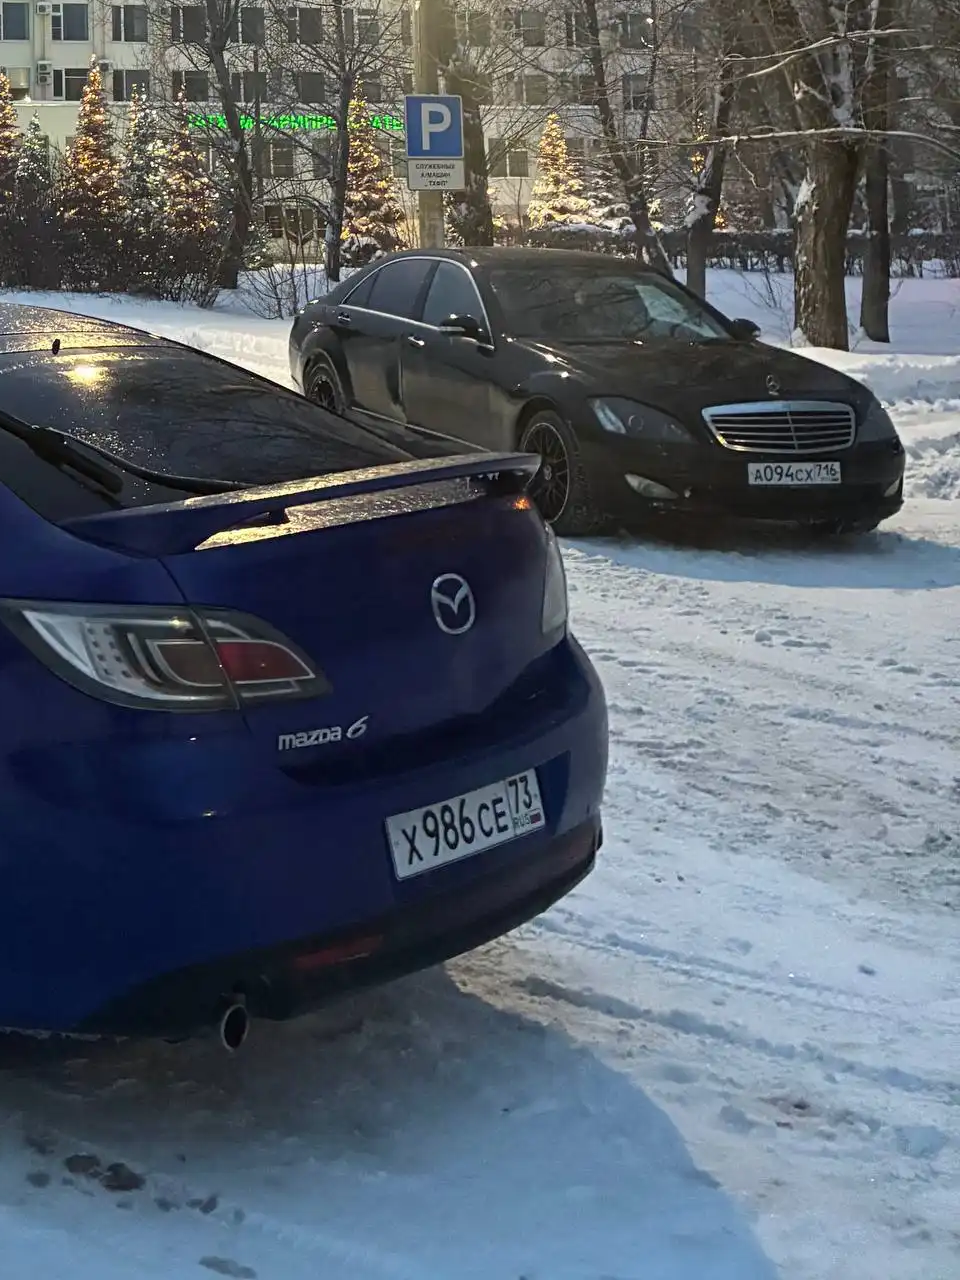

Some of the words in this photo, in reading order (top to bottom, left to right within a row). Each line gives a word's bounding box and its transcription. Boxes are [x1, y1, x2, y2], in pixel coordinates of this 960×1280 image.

[421, 102, 452, 150] P
[278, 726, 342, 750] mazda
[346, 715, 369, 739] 6
[508, 775, 533, 814] 73
